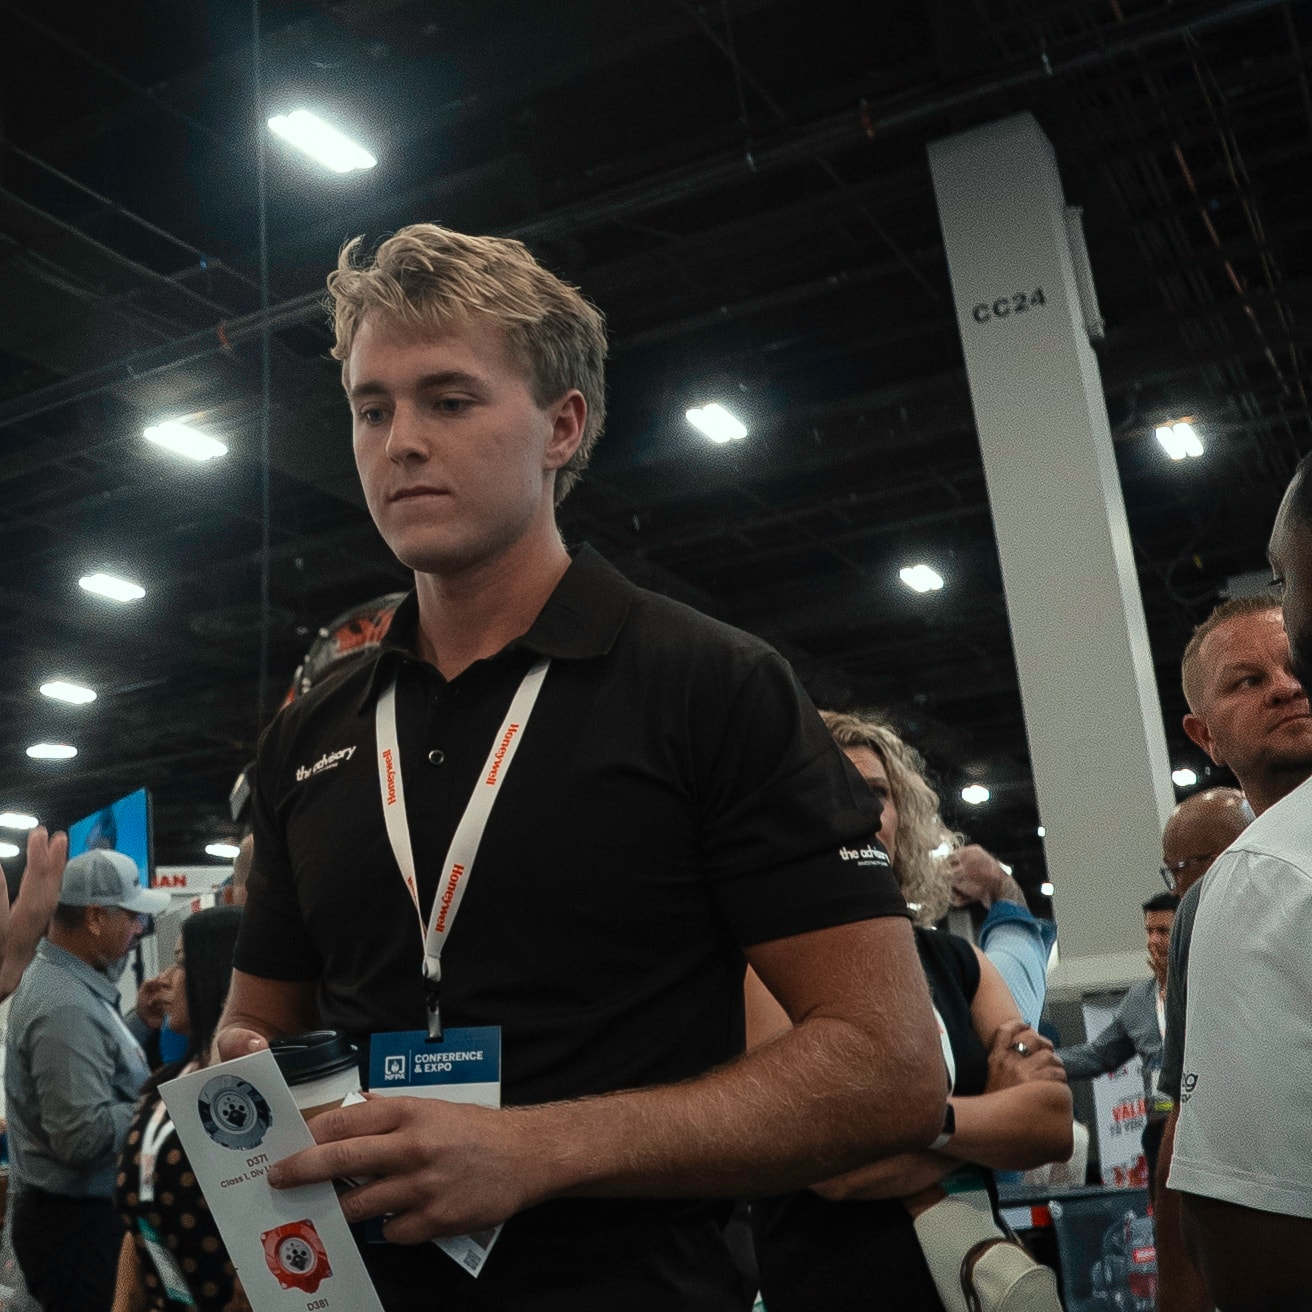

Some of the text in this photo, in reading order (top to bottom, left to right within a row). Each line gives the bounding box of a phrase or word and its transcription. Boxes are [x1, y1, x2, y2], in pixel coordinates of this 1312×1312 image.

[973, 288, 1046, 323] CC24
[486, 724, 519, 785] Honeywell
[383, 749, 396, 805] Honeywell
[839, 846, 859, 861] the
[435, 863, 465, 933] Honeywell
[415, 1051, 484, 1064] CONFERENCE
[414, 1062, 452, 1073] & EXPO
[246, 1154, 268, 1168] D371
[220, 1175, 244, 1188] Class
[250, 1170, 264, 1178] Div
[307, 1298, 329, 1311] D381
